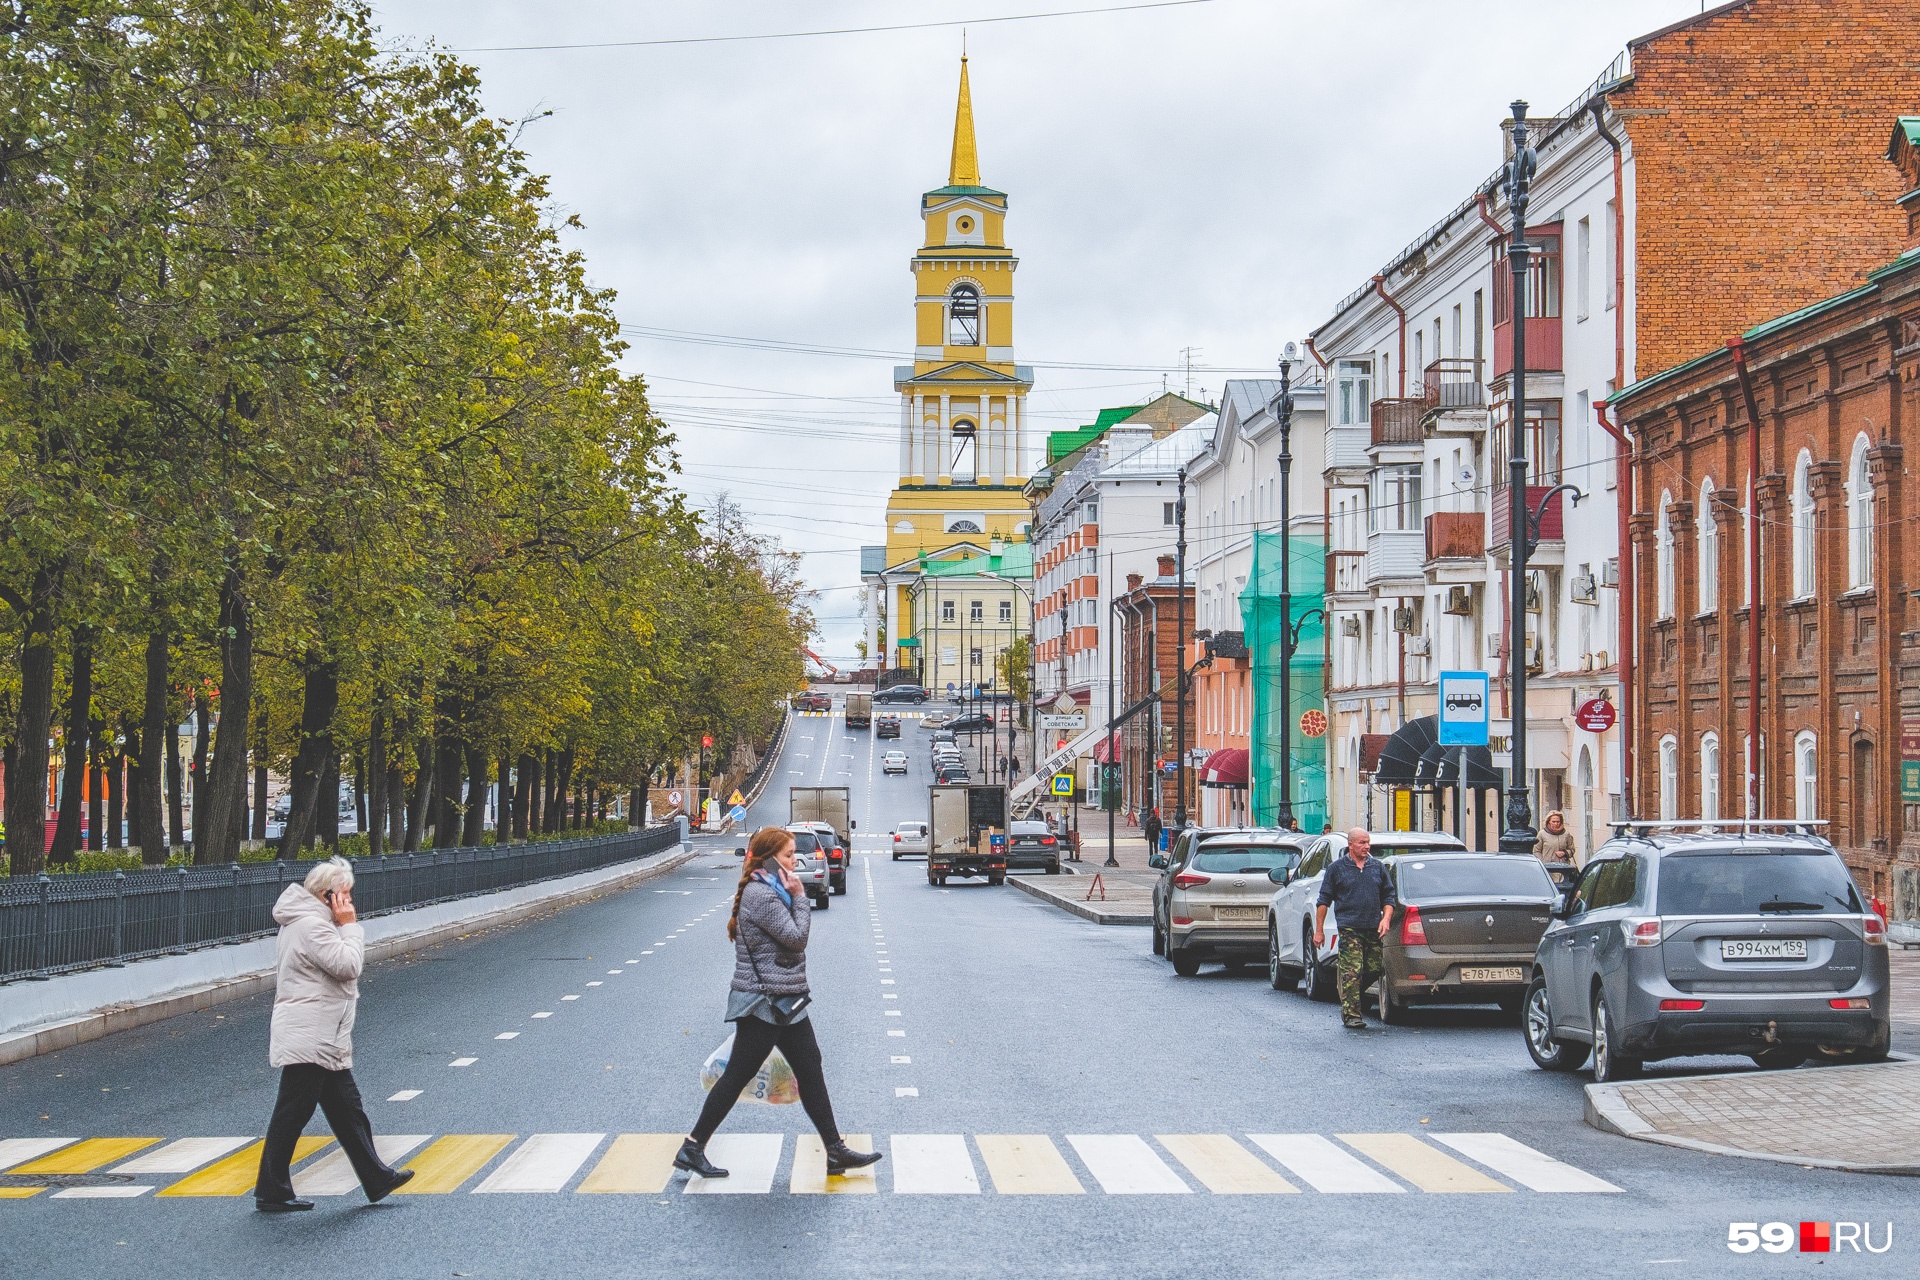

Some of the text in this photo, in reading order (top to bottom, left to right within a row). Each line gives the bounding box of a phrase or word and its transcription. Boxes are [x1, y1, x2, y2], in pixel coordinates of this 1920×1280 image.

[1727, 941, 1803, 956] В994ХМ 159
[1464, 968, 1521, 980] Е787ЕТ 159
